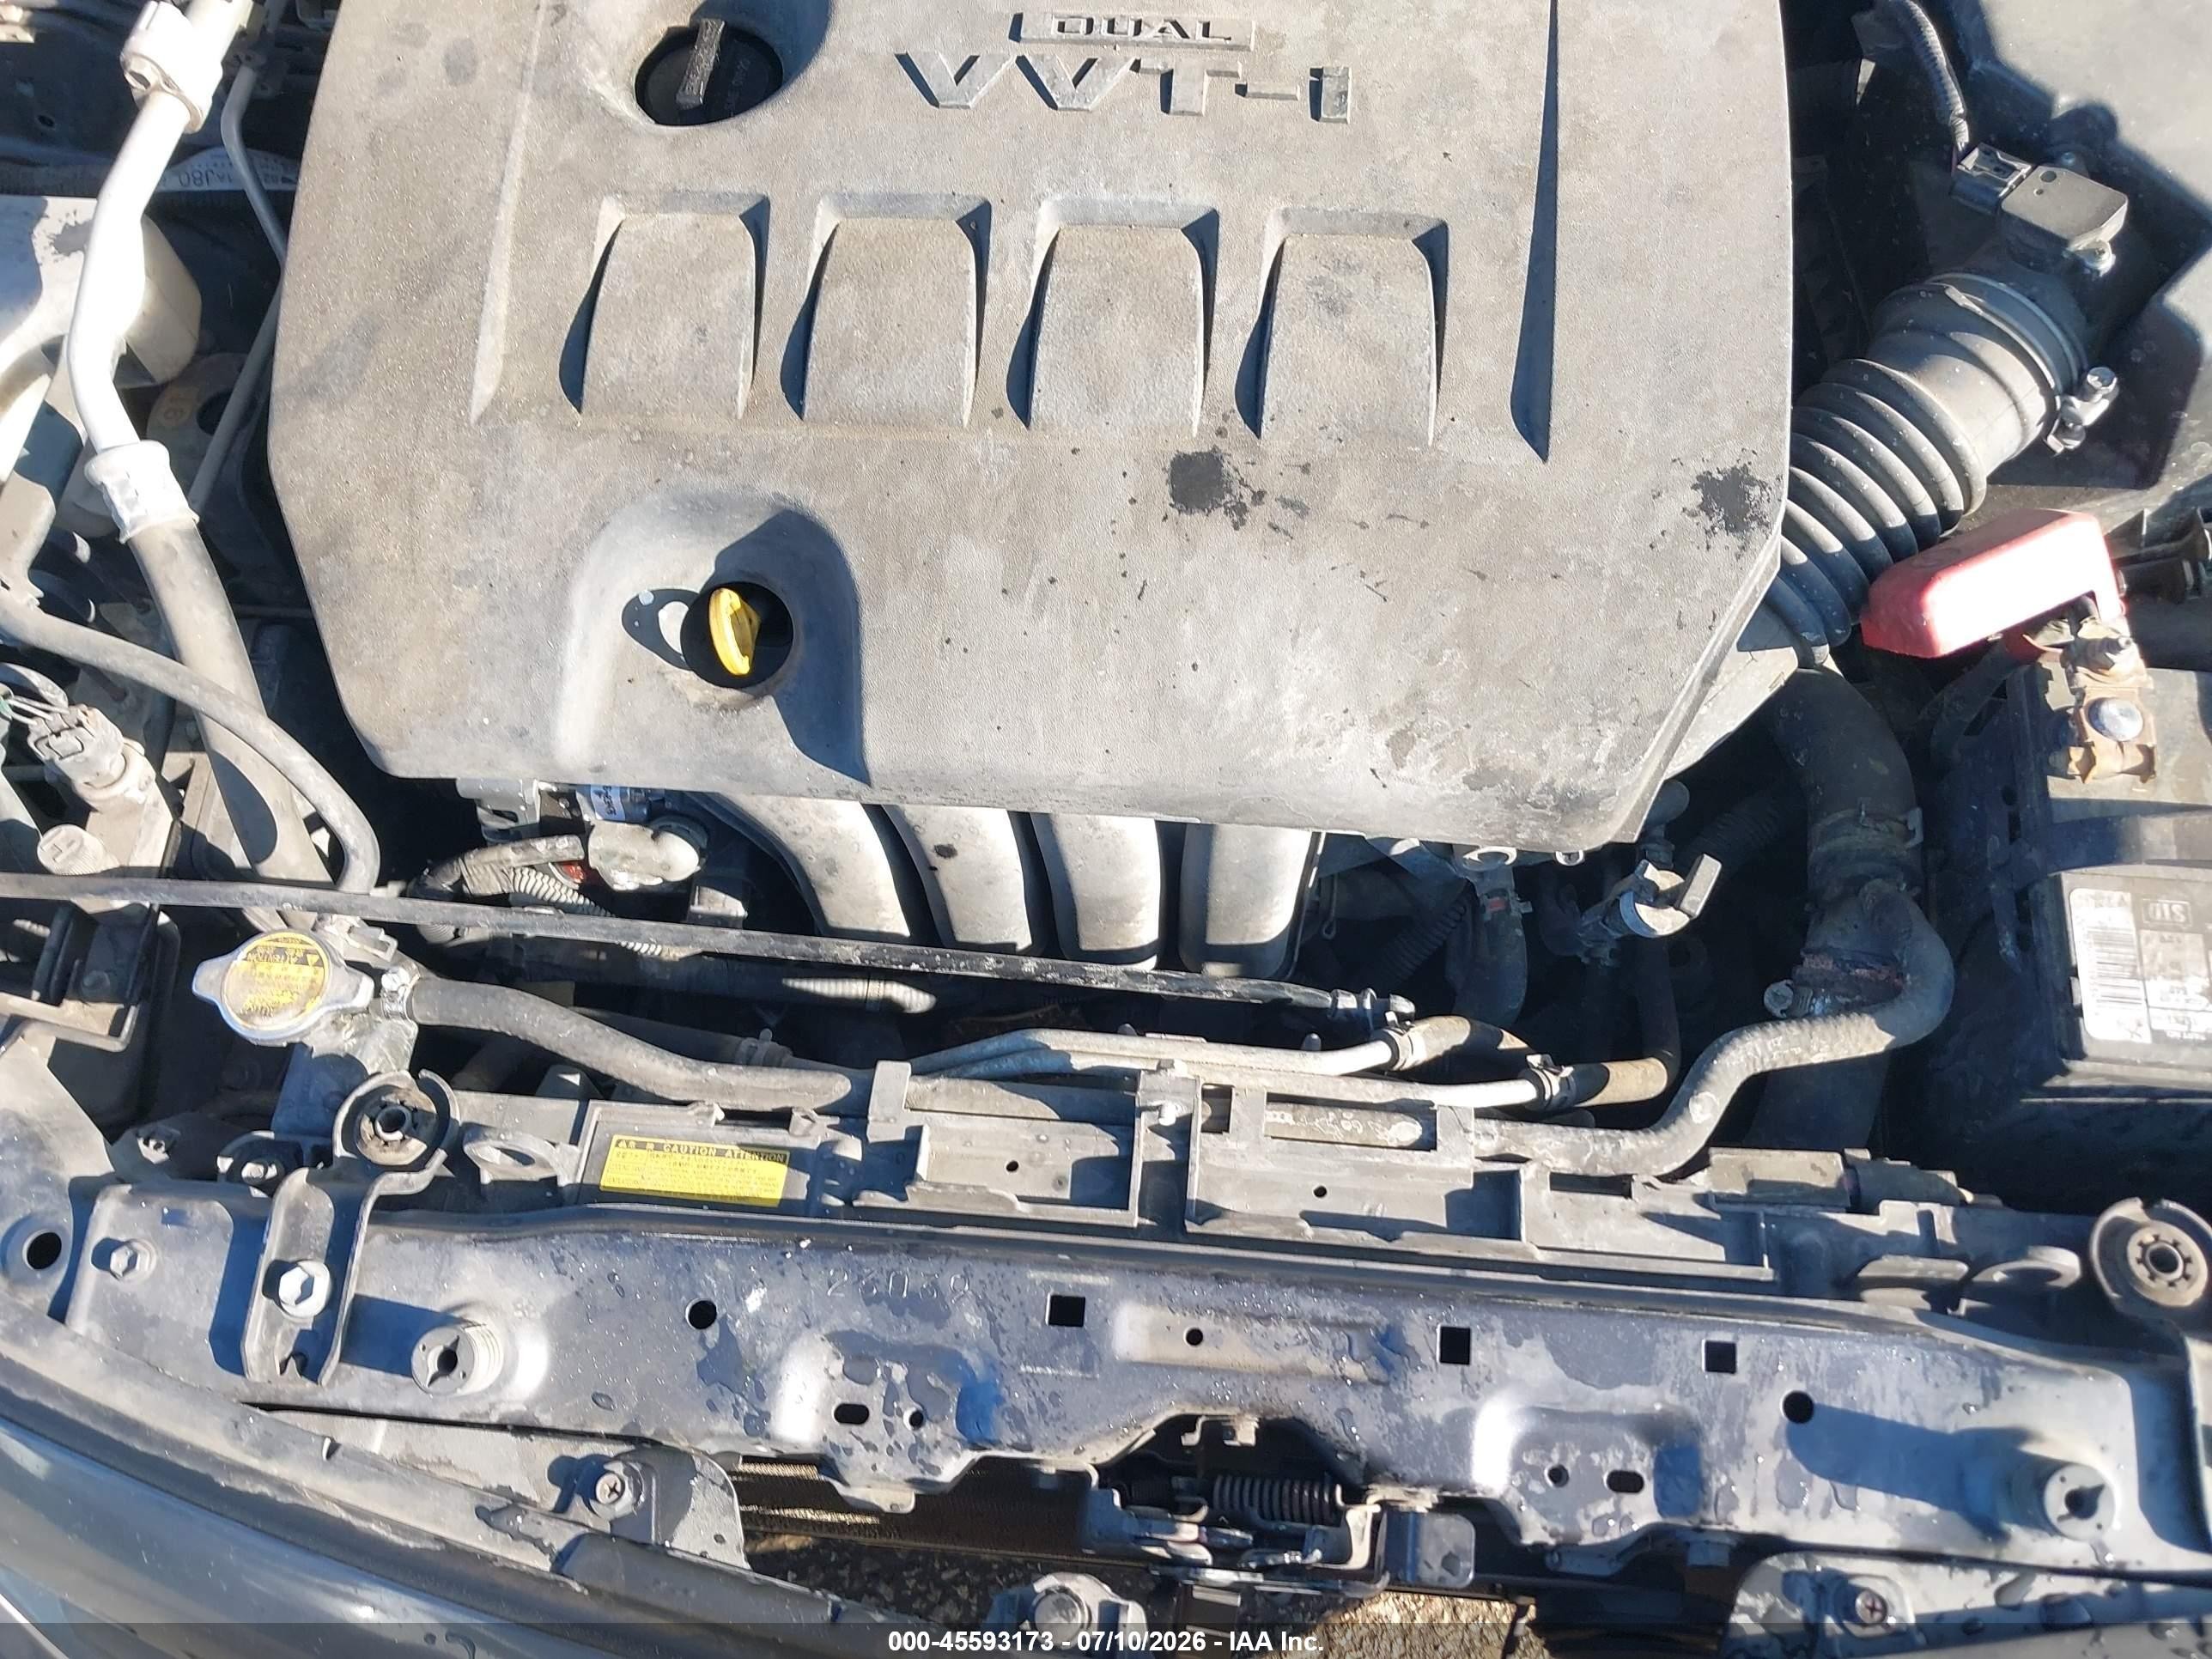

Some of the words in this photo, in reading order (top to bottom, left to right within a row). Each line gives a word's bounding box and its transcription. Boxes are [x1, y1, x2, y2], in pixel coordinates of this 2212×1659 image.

[1051, 15, 1232, 40] DUAL
[663, 1142, 717, 1157] CAUTION
[725, 1150, 784, 1163] ATTENTION
